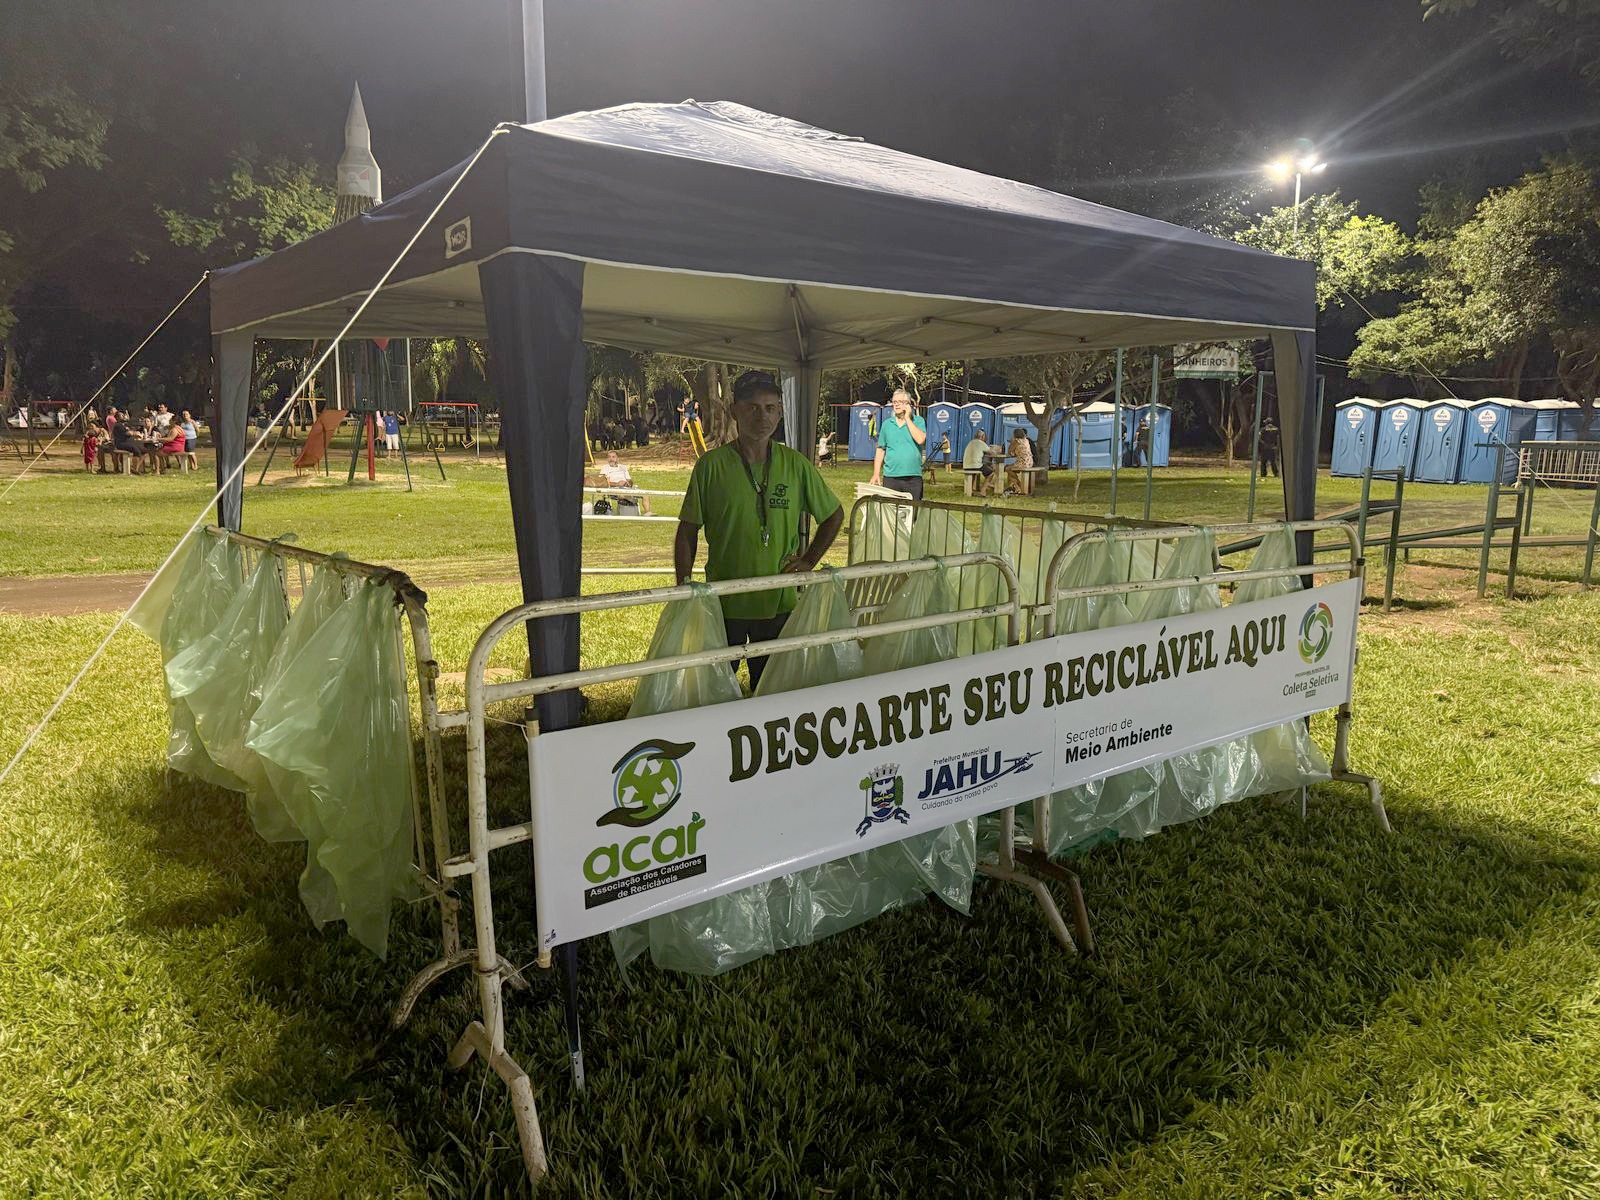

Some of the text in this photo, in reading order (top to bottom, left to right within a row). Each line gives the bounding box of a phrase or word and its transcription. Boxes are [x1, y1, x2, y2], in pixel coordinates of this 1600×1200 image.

[727, 614, 1287, 783] DESCARTE SEU RECICLÁVEL AQUI
[1282, 681, 1308, 696] Coleta
[1308, 672, 1339, 689] Seletiva
[1065, 723, 1173, 764] Meio Ambiente
[1066, 718, 1133, 744] Secretaria de
[933, 746, 990, 766] Prefeitura Municipal
[917, 750, 1002, 799] JAHU
[921, 798, 953, 811] Cuidando
[964, 788, 981, 800] nosso
[982, 783, 998, 796] povo
[583, 818, 706, 884] acar
[590, 858, 702, 897] Associação dos Catadores
[617, 875, 678, 899] de Recicláveis
